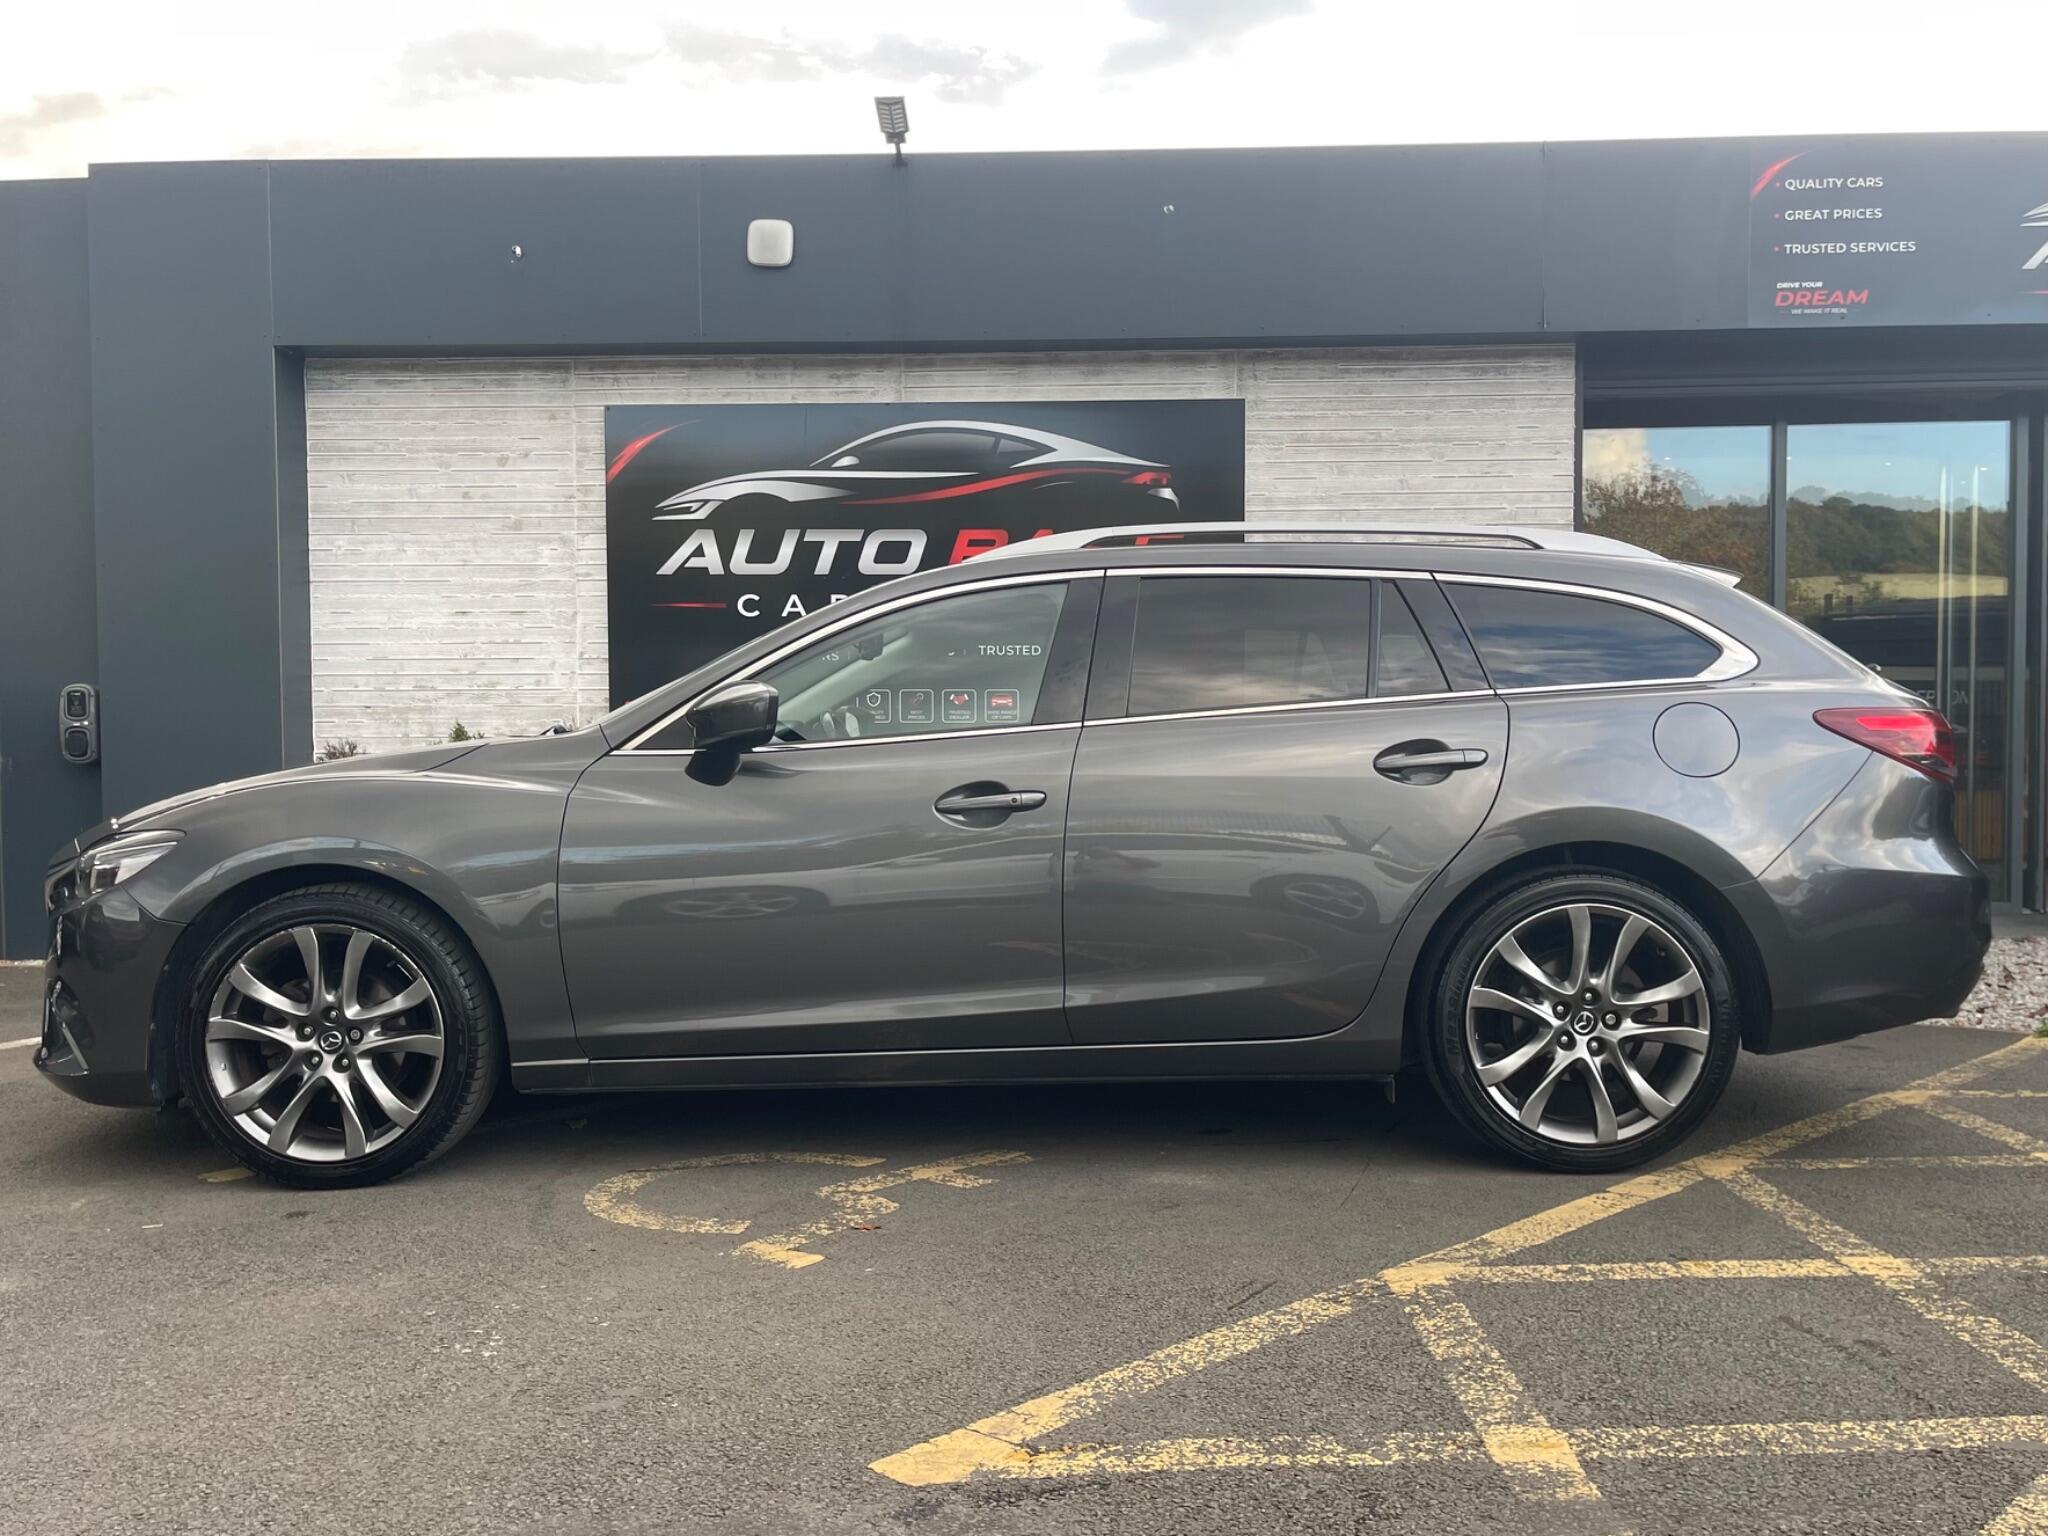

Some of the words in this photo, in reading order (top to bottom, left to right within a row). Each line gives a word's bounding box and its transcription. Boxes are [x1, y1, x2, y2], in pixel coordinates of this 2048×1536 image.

[1785, 178, 1843, 190] QUALITY
[1847, 177, 1884, 188] CARS
[1785, 209, 1830, 221] GREAT
[1833, 208, 1883, 219] PRICES
[1784, 243, 1847, 254] TRUSTED
[1850, 241, 1916, 253] SERVICES
[1775, 289, 1869, 307] DREAM
[656, 529, 928, 575] AUTO
[978, 645, 1041, 656] TRUSTED
